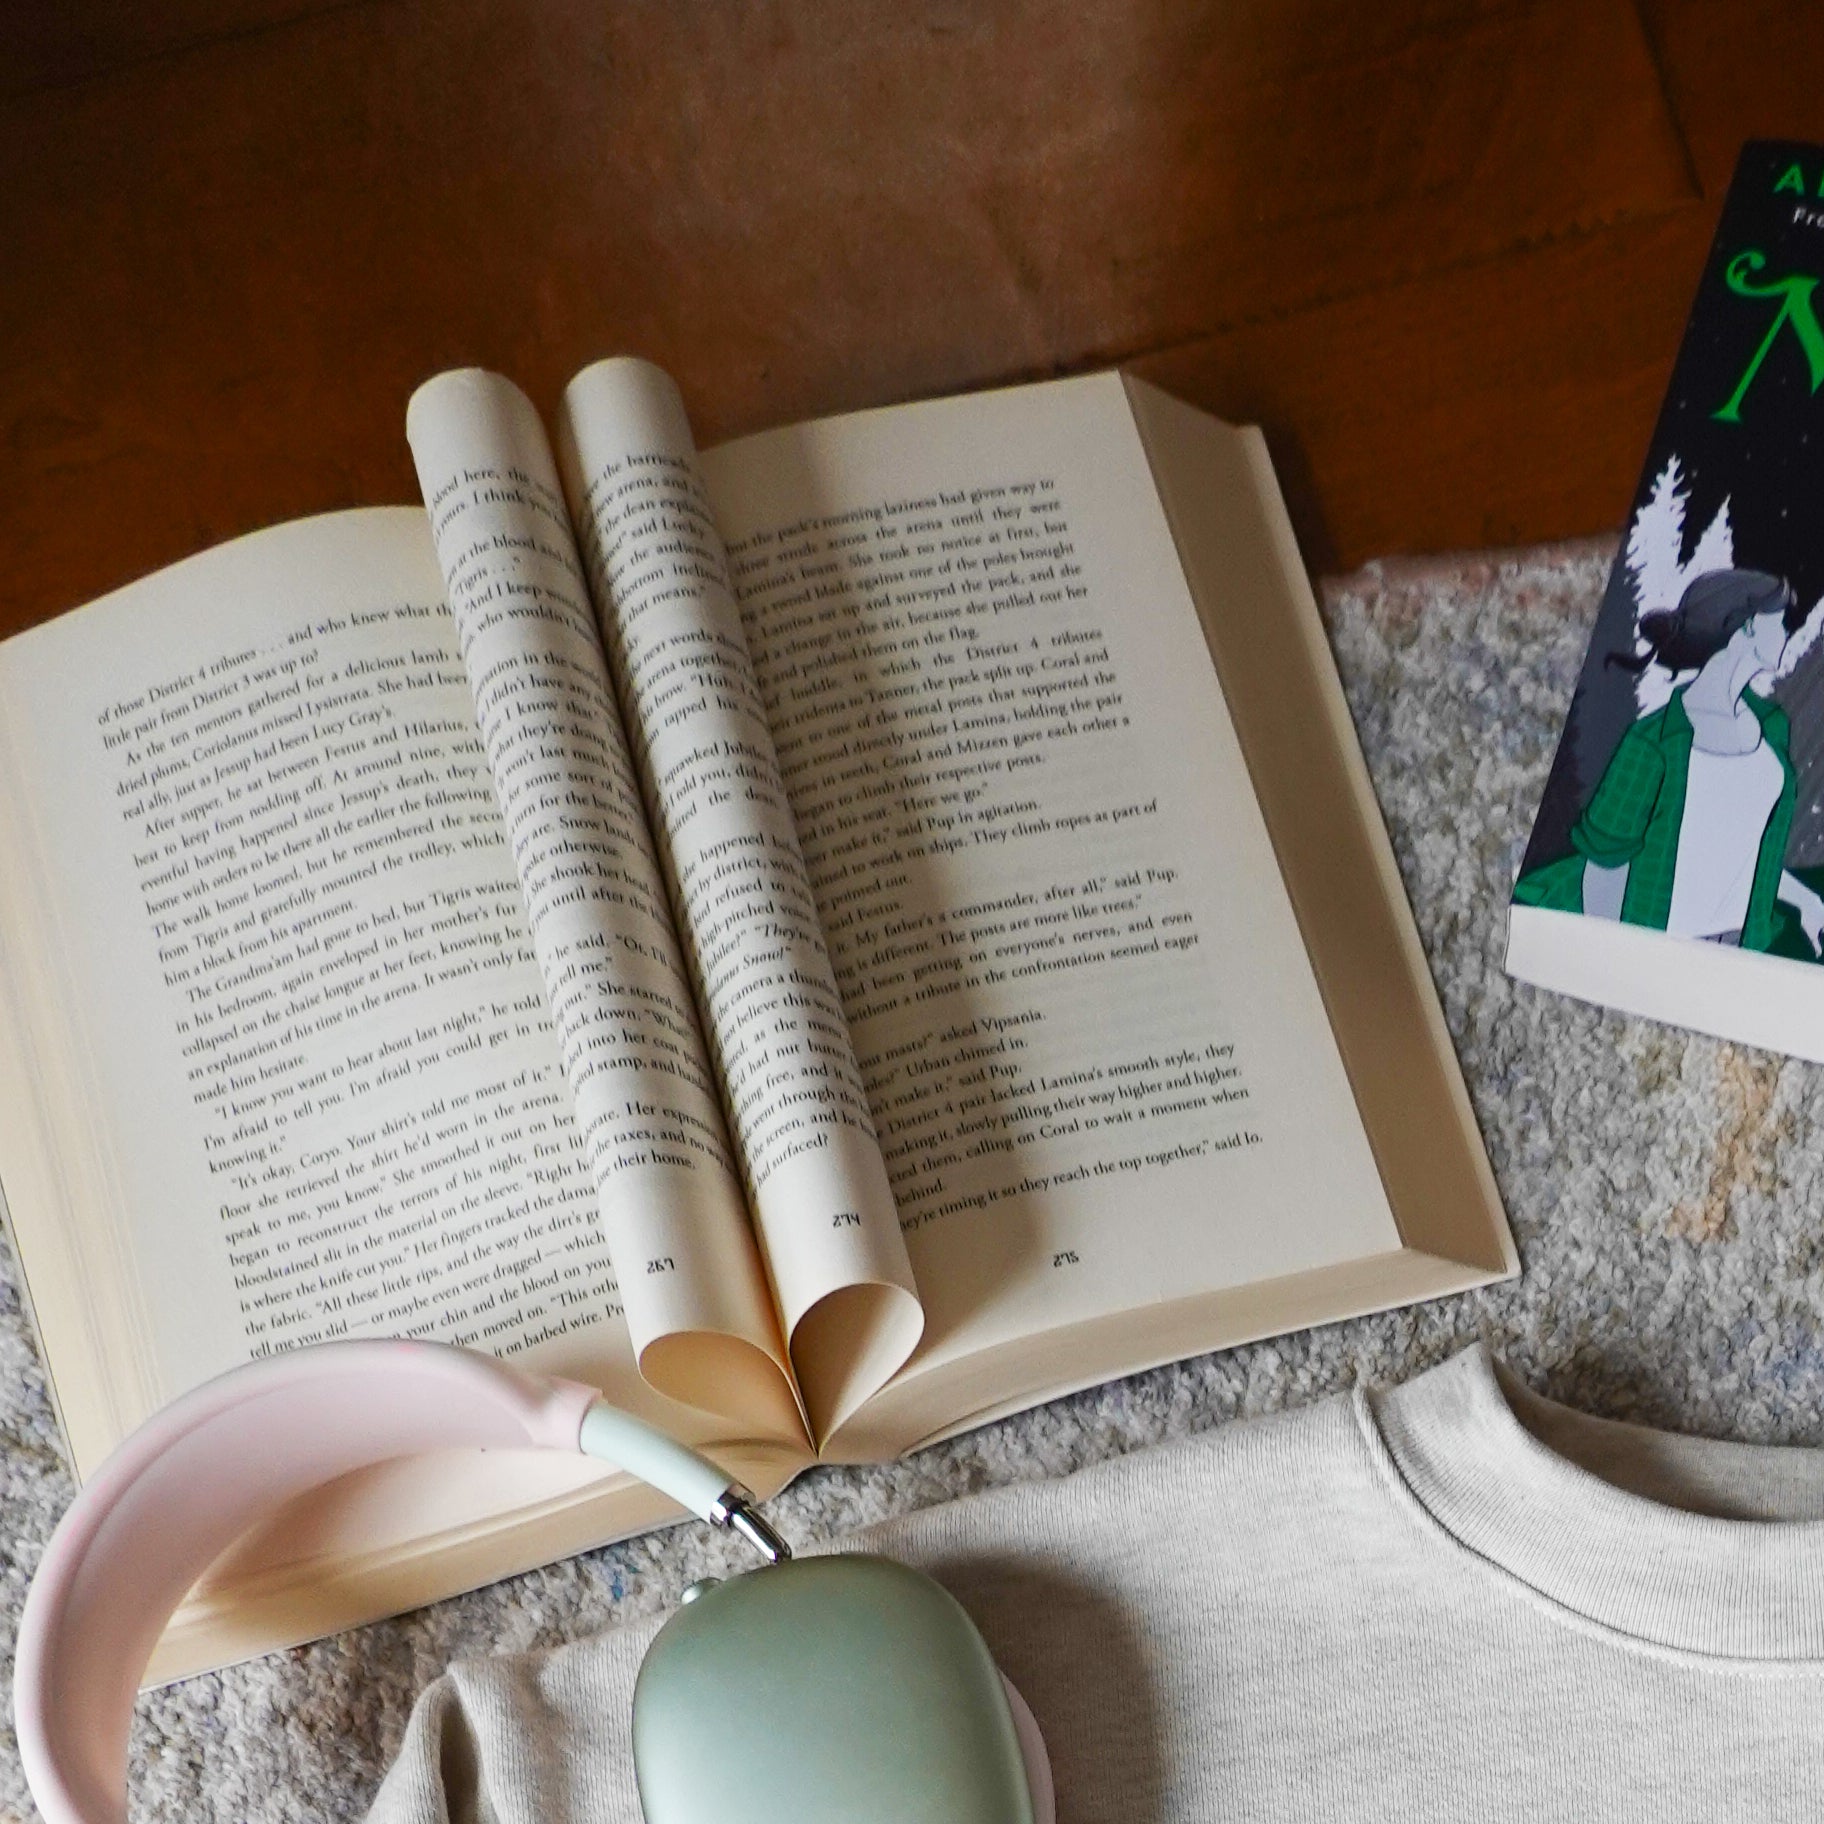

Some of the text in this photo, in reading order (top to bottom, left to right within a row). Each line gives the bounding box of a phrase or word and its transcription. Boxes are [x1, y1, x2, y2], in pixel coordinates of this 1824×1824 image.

[887, 1109, 939, 1135] District
[960, 1096, 986, 1115] pair
[988, 1080, 1037, 1105] lacked
[1041, 1067, 1102, 1091] Lamina's
[1108, 1057, 1159, 1076] smooth
[1206, 1045, 1234, 1058] they
[937, 1191, 987, 1218] timing
[988, 1191, 997, 1201] it
[1001, 1187, 1018, 1200] so
[1018, 1178, 1050, 1200] they
[1053, 1168, 1089, 1185] reach
[1094, 1163, 1114, 1175] the
[1119, 1159, 1141, 1171] top
[1215, 1134, 1241, 1150] said
[241, 1302, 250, 1312] is
[254, 1292, 291, 1308] where
[296, 1282, 315, 1296] the
[319, 1270, 352, 1289] knife
[357, 1264, 375, 1278] cut
[415, 1242, 437, 1256] Her
[441, 1225, 482, 1246] fingers
[485, 1203, 530, 1228] tracked
[534, 1197, 553, 1210] the
[831, 1213, 861, 1230] 274
[1054, 1251, 1079, 1267] 275
[246, 1322, 265, 1335] the
[347, 1289, 377, 1306] these
[383, 1276, 410, 1294] little
[447, 1252, 469, 1271] and
[473, 1247, 491, 1260] the
[496, 1237, 518, 1253] way
[524, 1225, 542, 1240] the
[648, 1258, 674, 1272] 267
